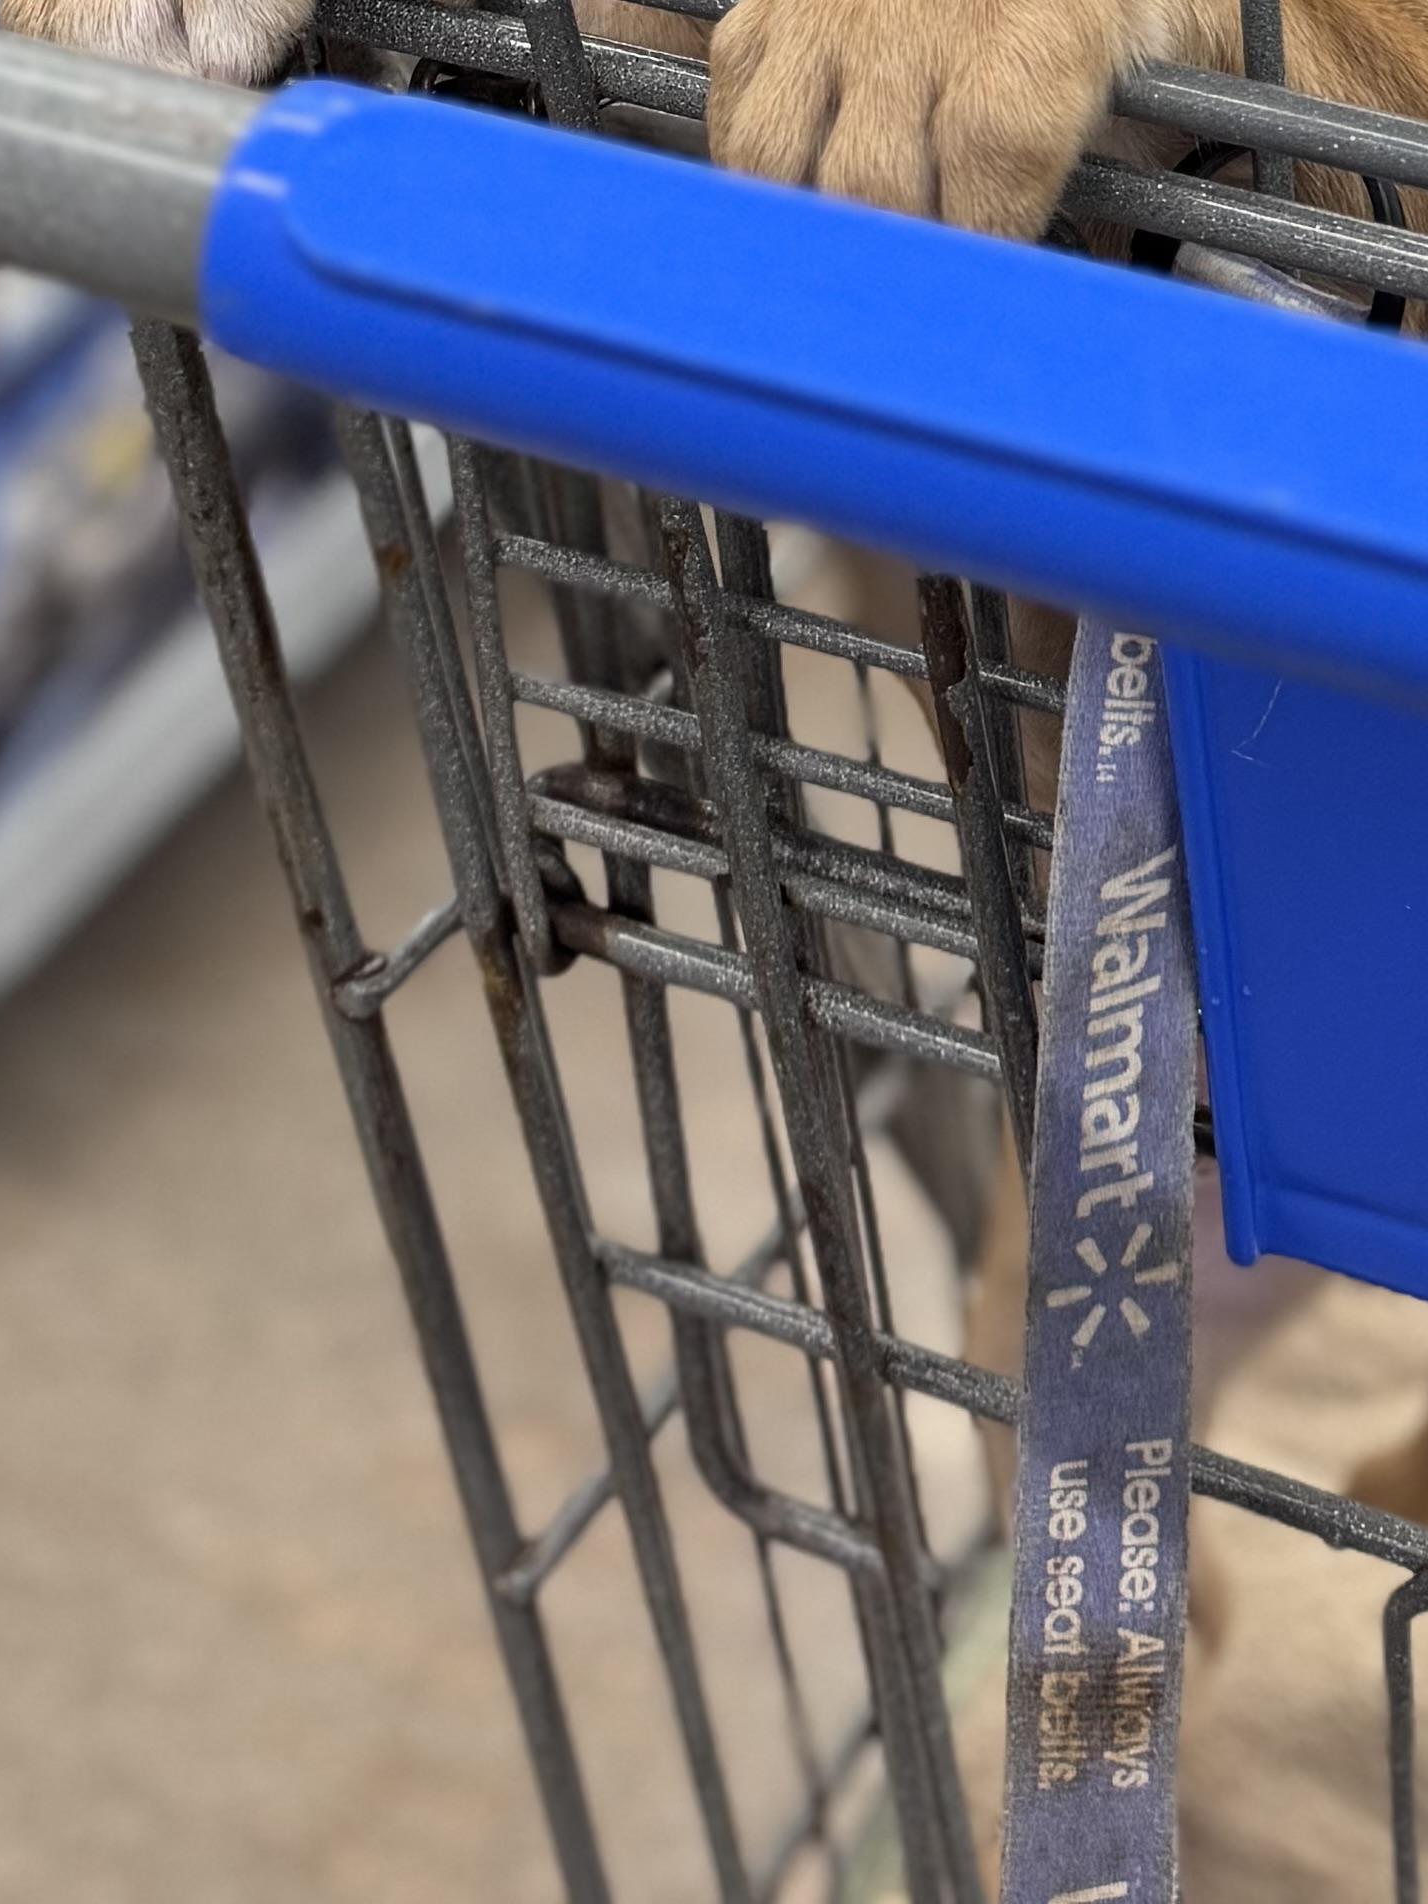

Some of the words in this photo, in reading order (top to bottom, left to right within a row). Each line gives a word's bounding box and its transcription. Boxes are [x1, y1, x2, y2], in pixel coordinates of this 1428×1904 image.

[1098, 631, 1159, 755] belts.
[1076, 843, 1178, 1218] Walmart
[1047, 1459, 1090, 1542] use
[1117, 1437, 1174, 1614] Please:
[1041, 1555, 1090, 1658] seat
[1103, 1625, 1167, 1790] Always
